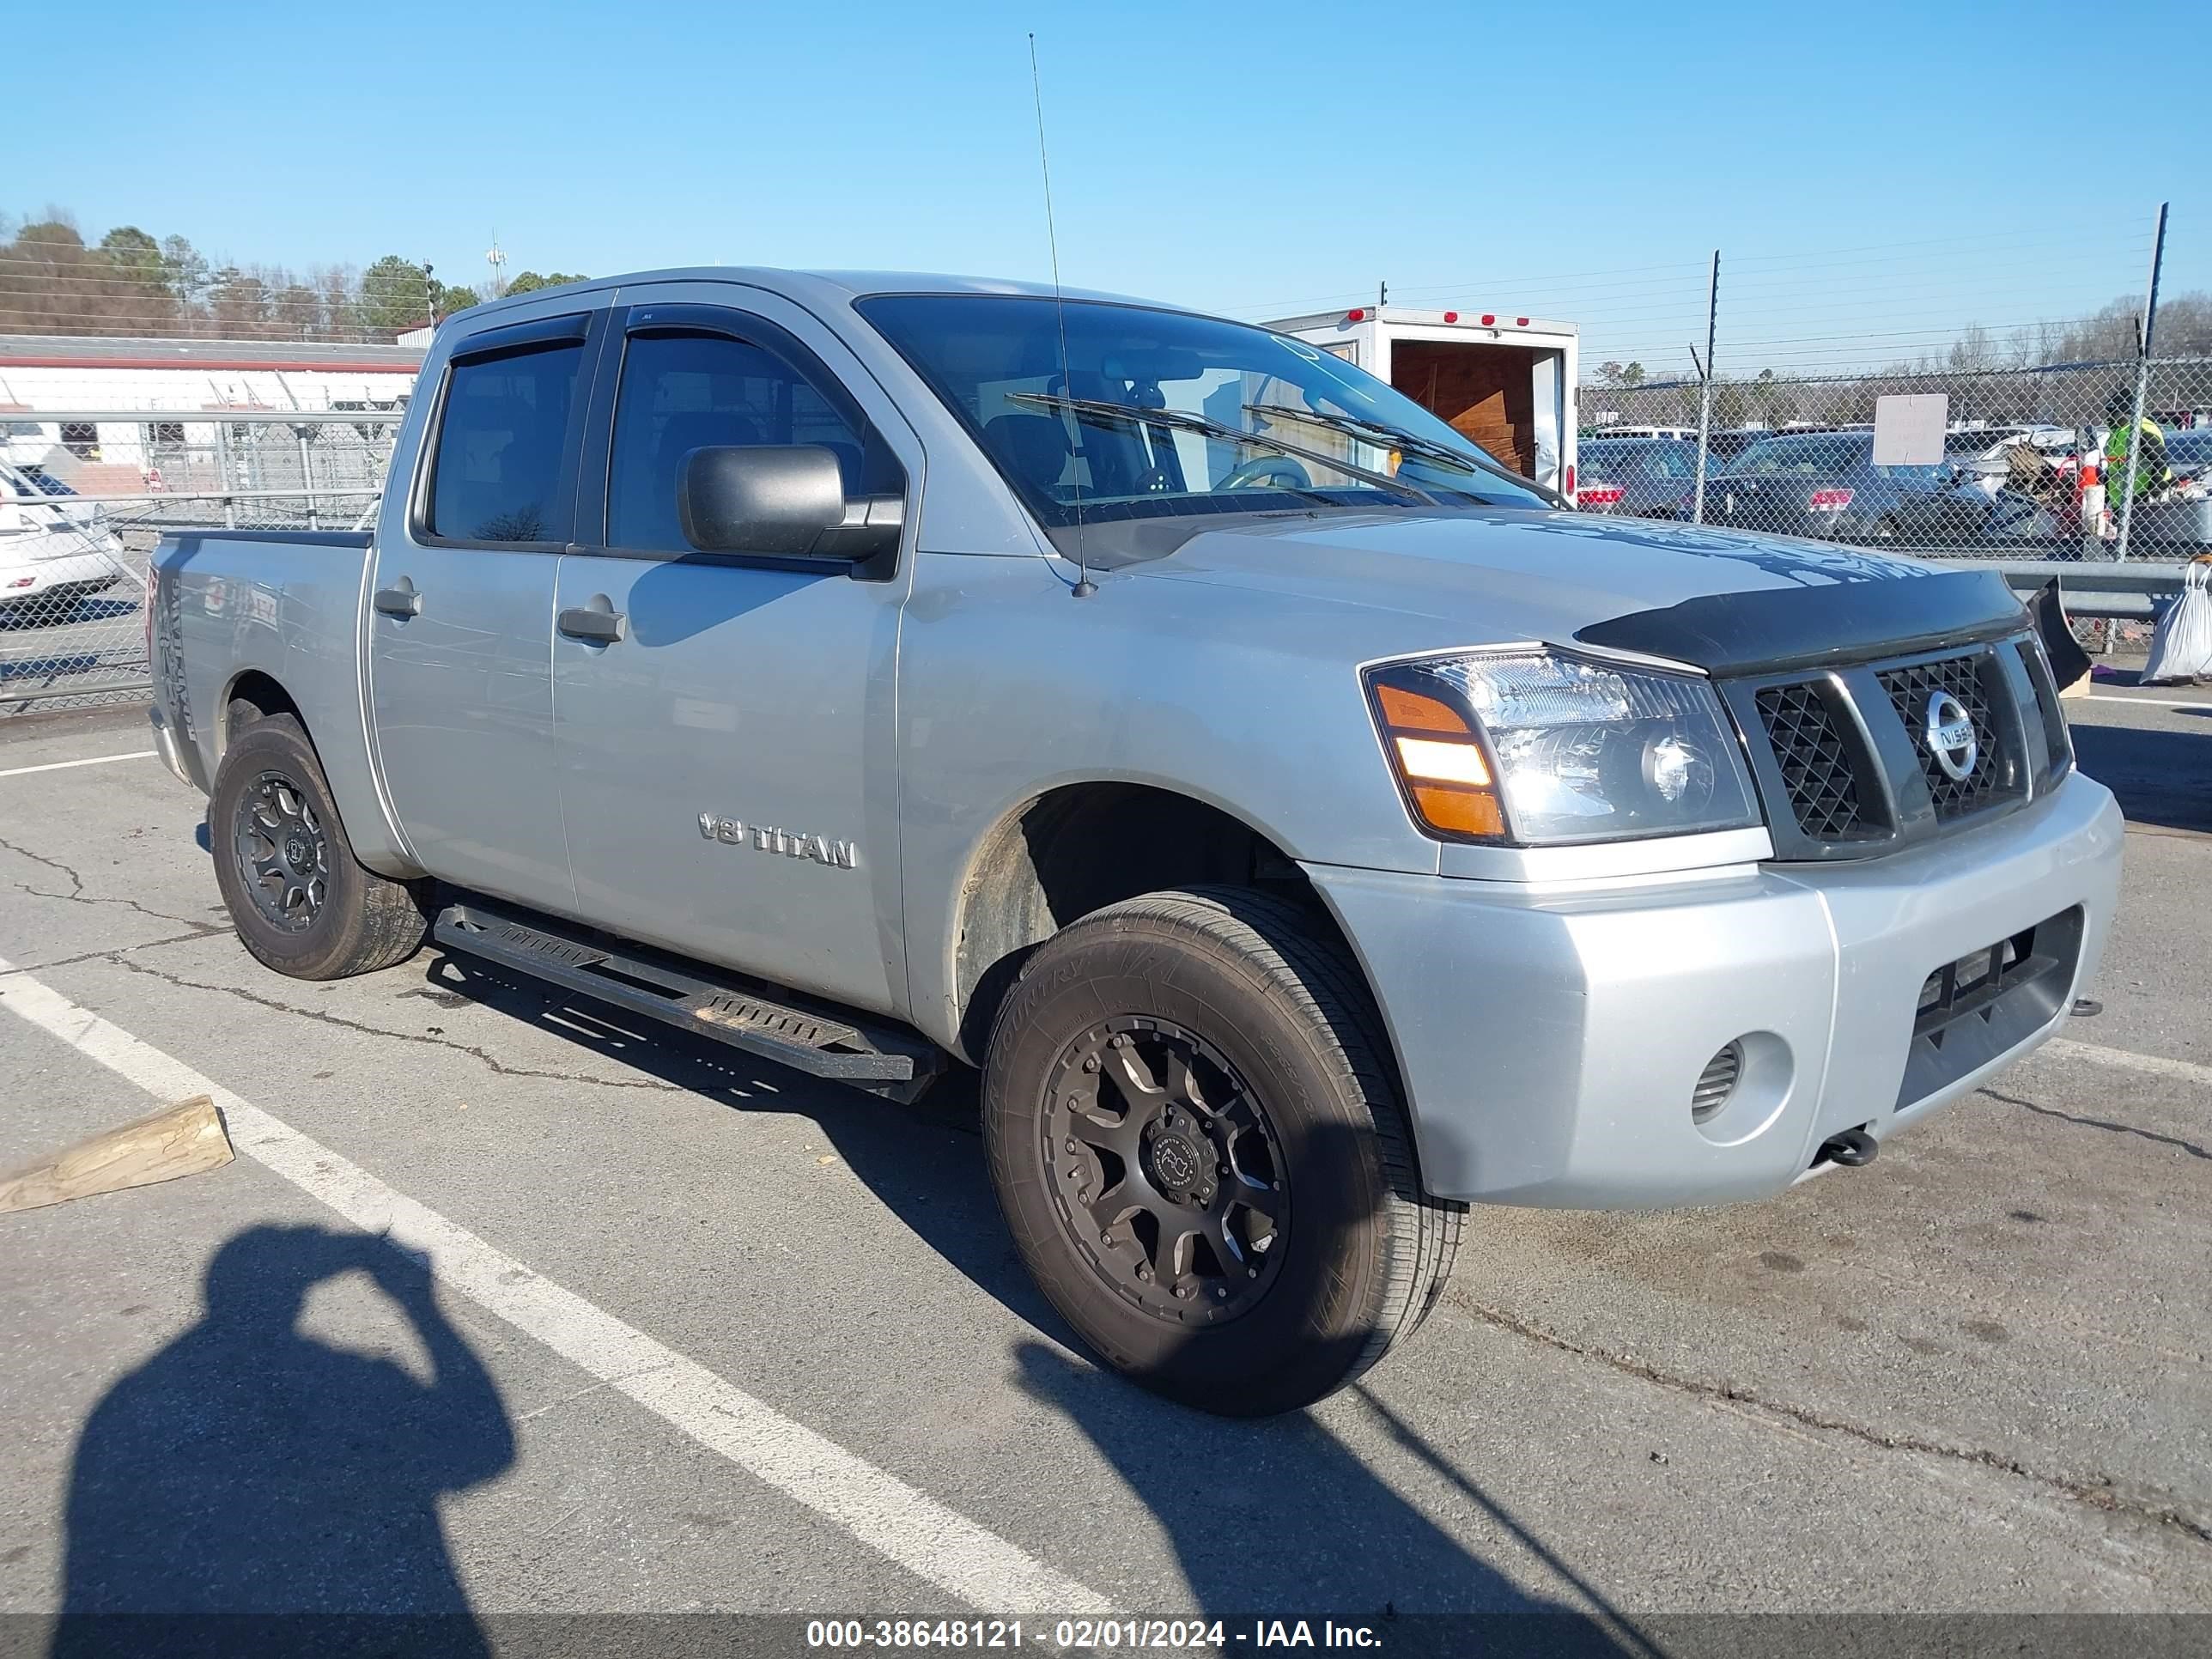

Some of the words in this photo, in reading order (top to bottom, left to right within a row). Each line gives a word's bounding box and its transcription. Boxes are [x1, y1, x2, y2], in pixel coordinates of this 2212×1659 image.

[1941, 725, 1973, 745] NISS
[697, 811, 744, 845] V8
[748, 824, 857, 869] TITAN
